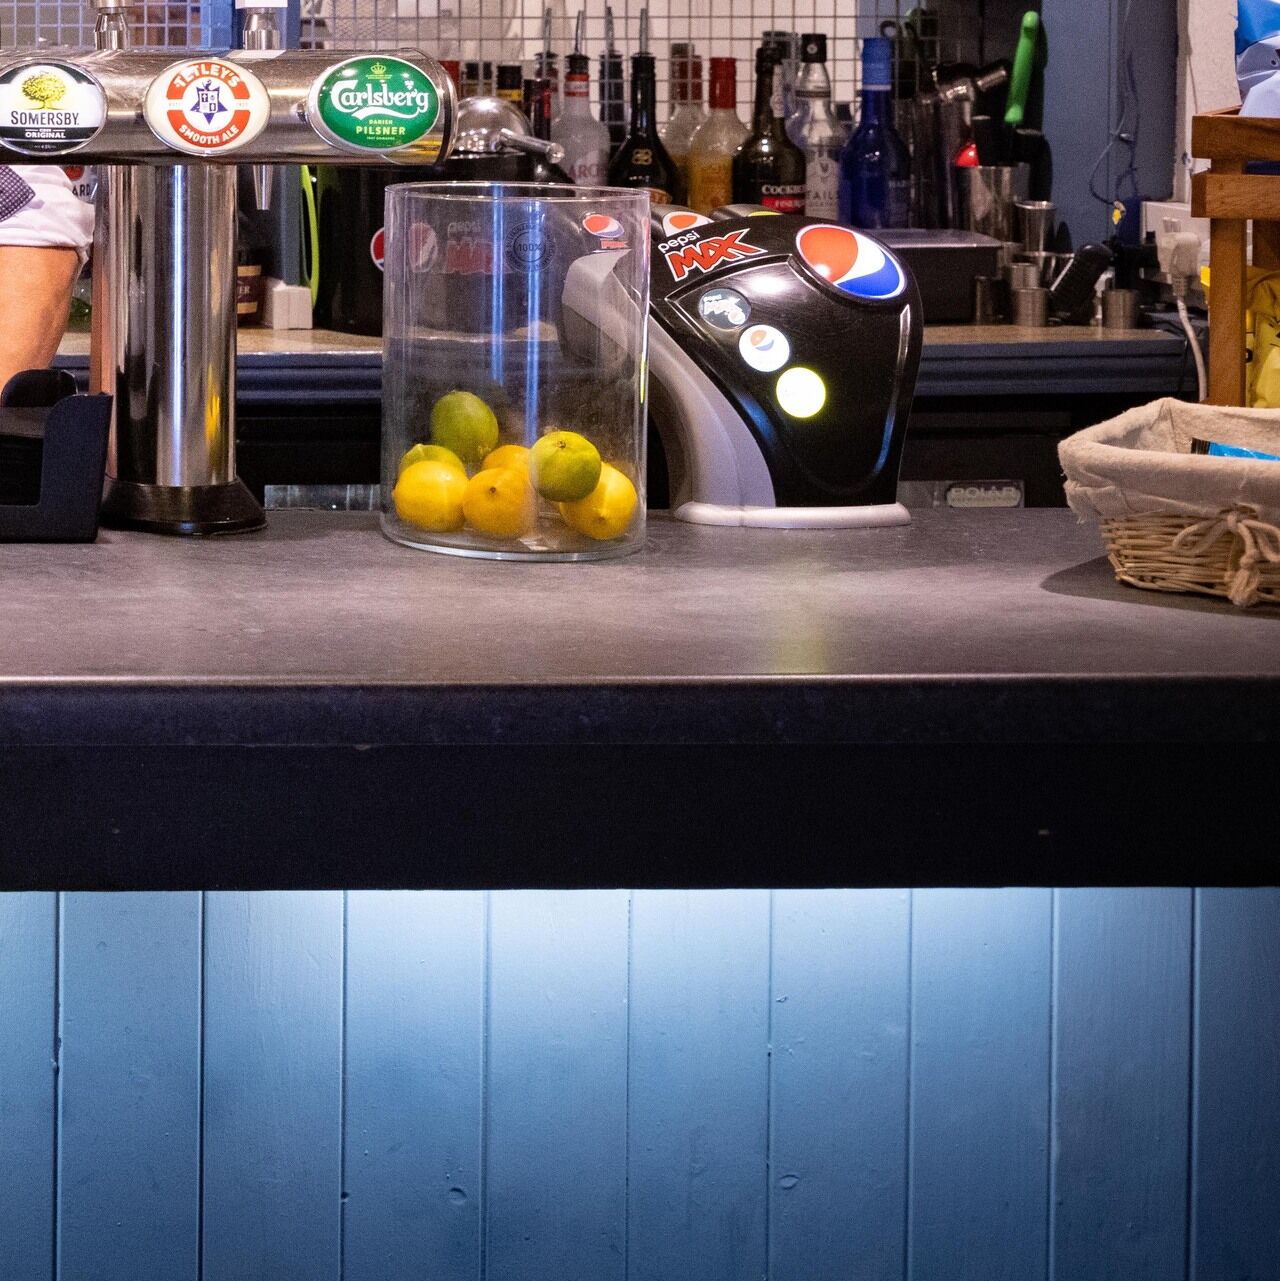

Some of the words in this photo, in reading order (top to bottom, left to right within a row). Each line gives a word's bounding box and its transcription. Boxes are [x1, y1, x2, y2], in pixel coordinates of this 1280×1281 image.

[172, 63, 242, 89] TETLEY'S
[330, 79, 430, 114] Carlsberg
[10, 110, 80, 126] SOMERSBY
[24, 131, 67, 139] ORIGINAL
[178, 123, 220, 145] SMOOTH
[221, 124, 240, 139] ALE
[355, 125, 407, 136] PILSNER
[518, 242, 541, 253] 100%
[657, 230, 701, 254] pepsi
[664, 227, 769, 283] MAX
